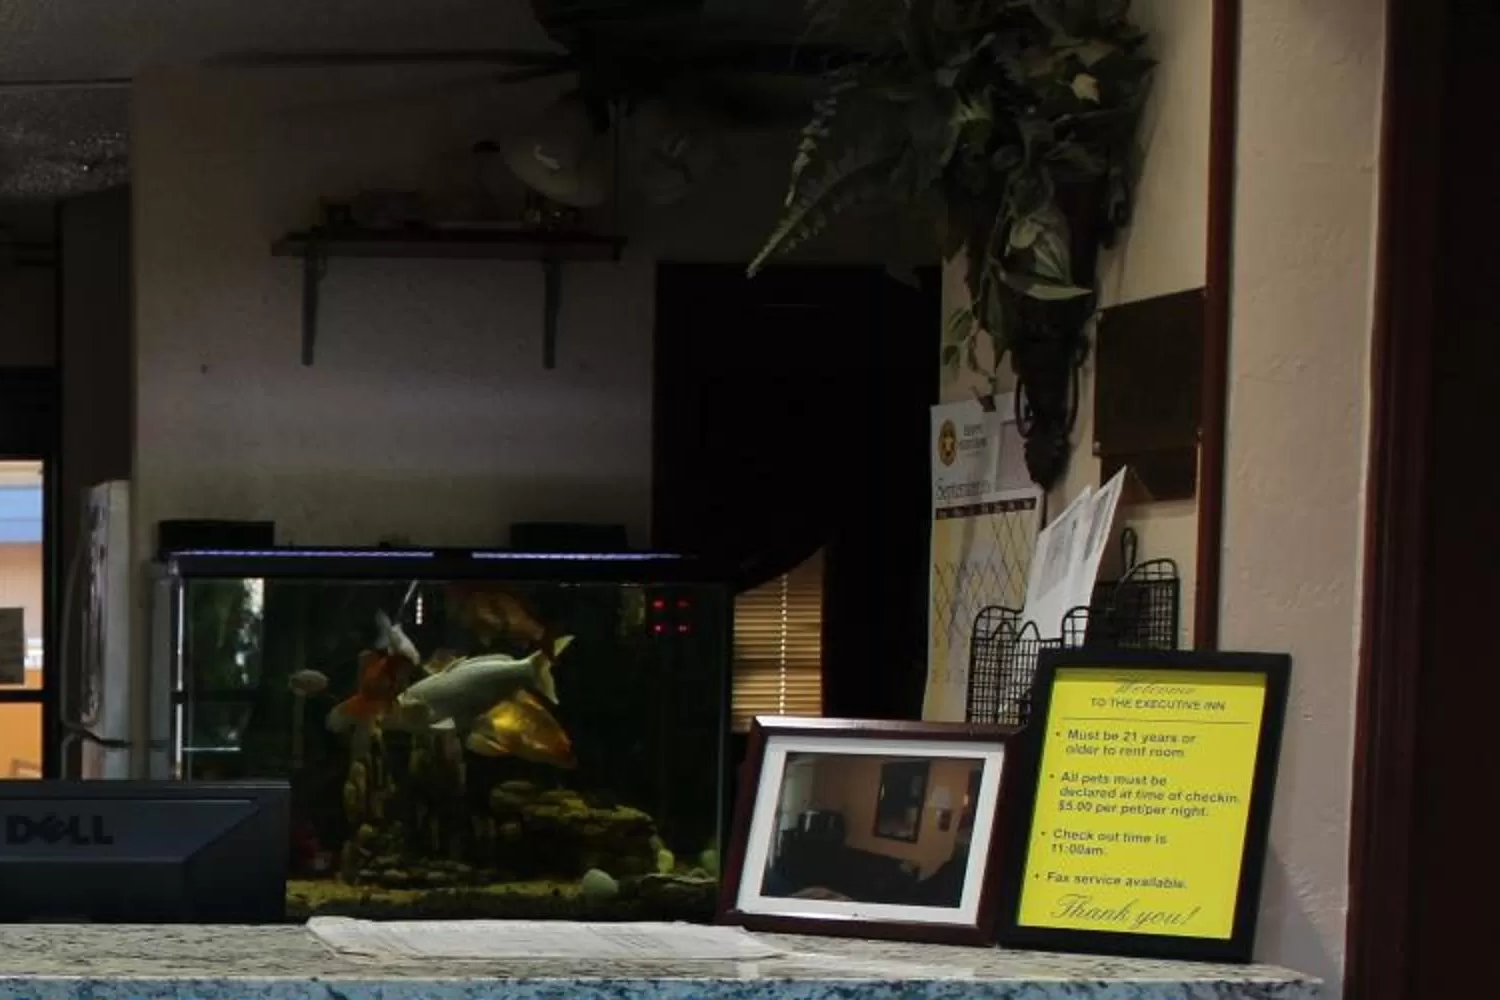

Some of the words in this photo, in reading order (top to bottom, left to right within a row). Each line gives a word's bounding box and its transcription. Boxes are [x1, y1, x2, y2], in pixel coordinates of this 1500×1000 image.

[1092, 697, 1106, 708] TO
[1111, 698, 1132, 709] THE
[1135, 698, 1200, 711] EXECUTIVE
[1203, 700, 1226, 712] INN
[1067, 729, 1100, 741] Must
[1103, 730, 1119, 741] be
[1123, 731, 1138, 742] 21
[1141, 733, 1178, 745] years
[1181, 735, 1196, 744] or
[1065, 743, 1098, 756] older
[1103, 745, 1116, 756] to
[1119, 746, 1145, 757] rent
[1061, 771, 1079, 783] All
[1081, 774, 1109, 786] pets
[1113, 775, 1147, 786] must
[1150, 775, 1167, 787] be
[1059, 786, 1116, 798] declared
[1119, 789, 1132, 800] at
[1135, 790, 1164, 801] time
[1167, 791, 1182, 801] of
[1059, 800, 1093, 812] $5.00
[1095, 803, 1116, 815] per
[1170, 805, 1209, 819] night.
[6, 815, 114, 845] DELL
[1053, 829, 1094, 841] Check
[1097, 831, 1119, 842] out
[1123, 832, 1151, 844] time
[1155, 833, 1167, 845] is
[1047, 871, 1070, 883] Fax
[1074, 874, 1121, 886] service
[1125, 876, 1187, 889] available.
[1051, 893, 1140, 920] Thank
[1131, 906, 1202, 928] you!
